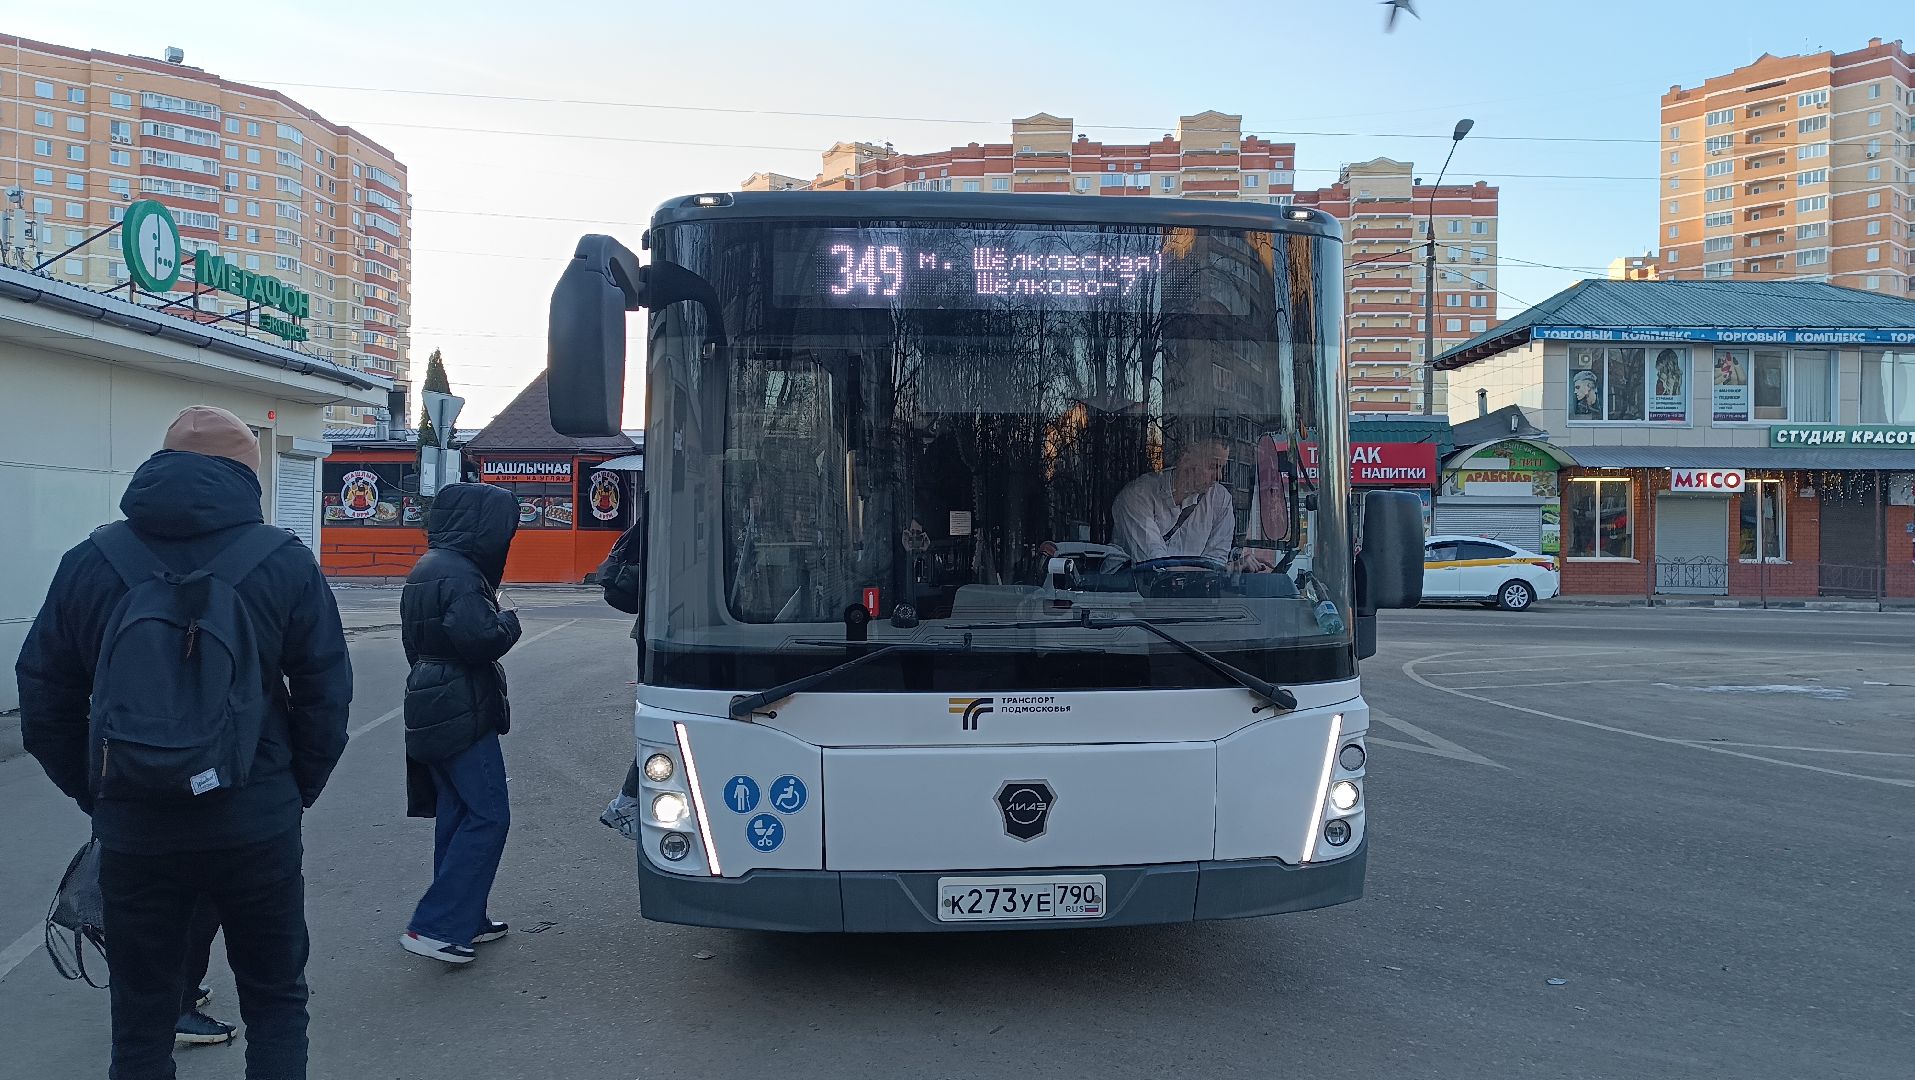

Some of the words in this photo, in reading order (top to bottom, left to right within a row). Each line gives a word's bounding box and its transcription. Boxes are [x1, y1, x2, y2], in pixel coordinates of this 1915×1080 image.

[831, 244, 903, 295] 349
[195, 249, 309, 318] МЕГАФОН
[1716, 330, 1787, 342] ТОРГОВЫЙ
[1795, 332, 1866, 343] КОМПЛЕКС
[1890, 333, 1915, 343] ТОР
[1777, 429, 1846, 445] СТУДИЯ
[1307, 446, 1382, 464] ТАК
[483, 462, 571, 474] ШАШЛЫЧНАЯ
[1361, 467, 1426, 479] НАПИТКИ
[1465, 471, 1532, 483] АРАБСКАЯ
[1674, 471, 1741, 489] МЯСО
[1001, 696, 1055, 704] ТРАНСПОРТ
[1001, 705, 1071, 714] ПОДМОСКОВЬЯ
[1005, 802, 1047, 811] ЛИАЗ
[1057, 885, 1095, 905] 790
[1065, 905, 1084, 913] RUS
